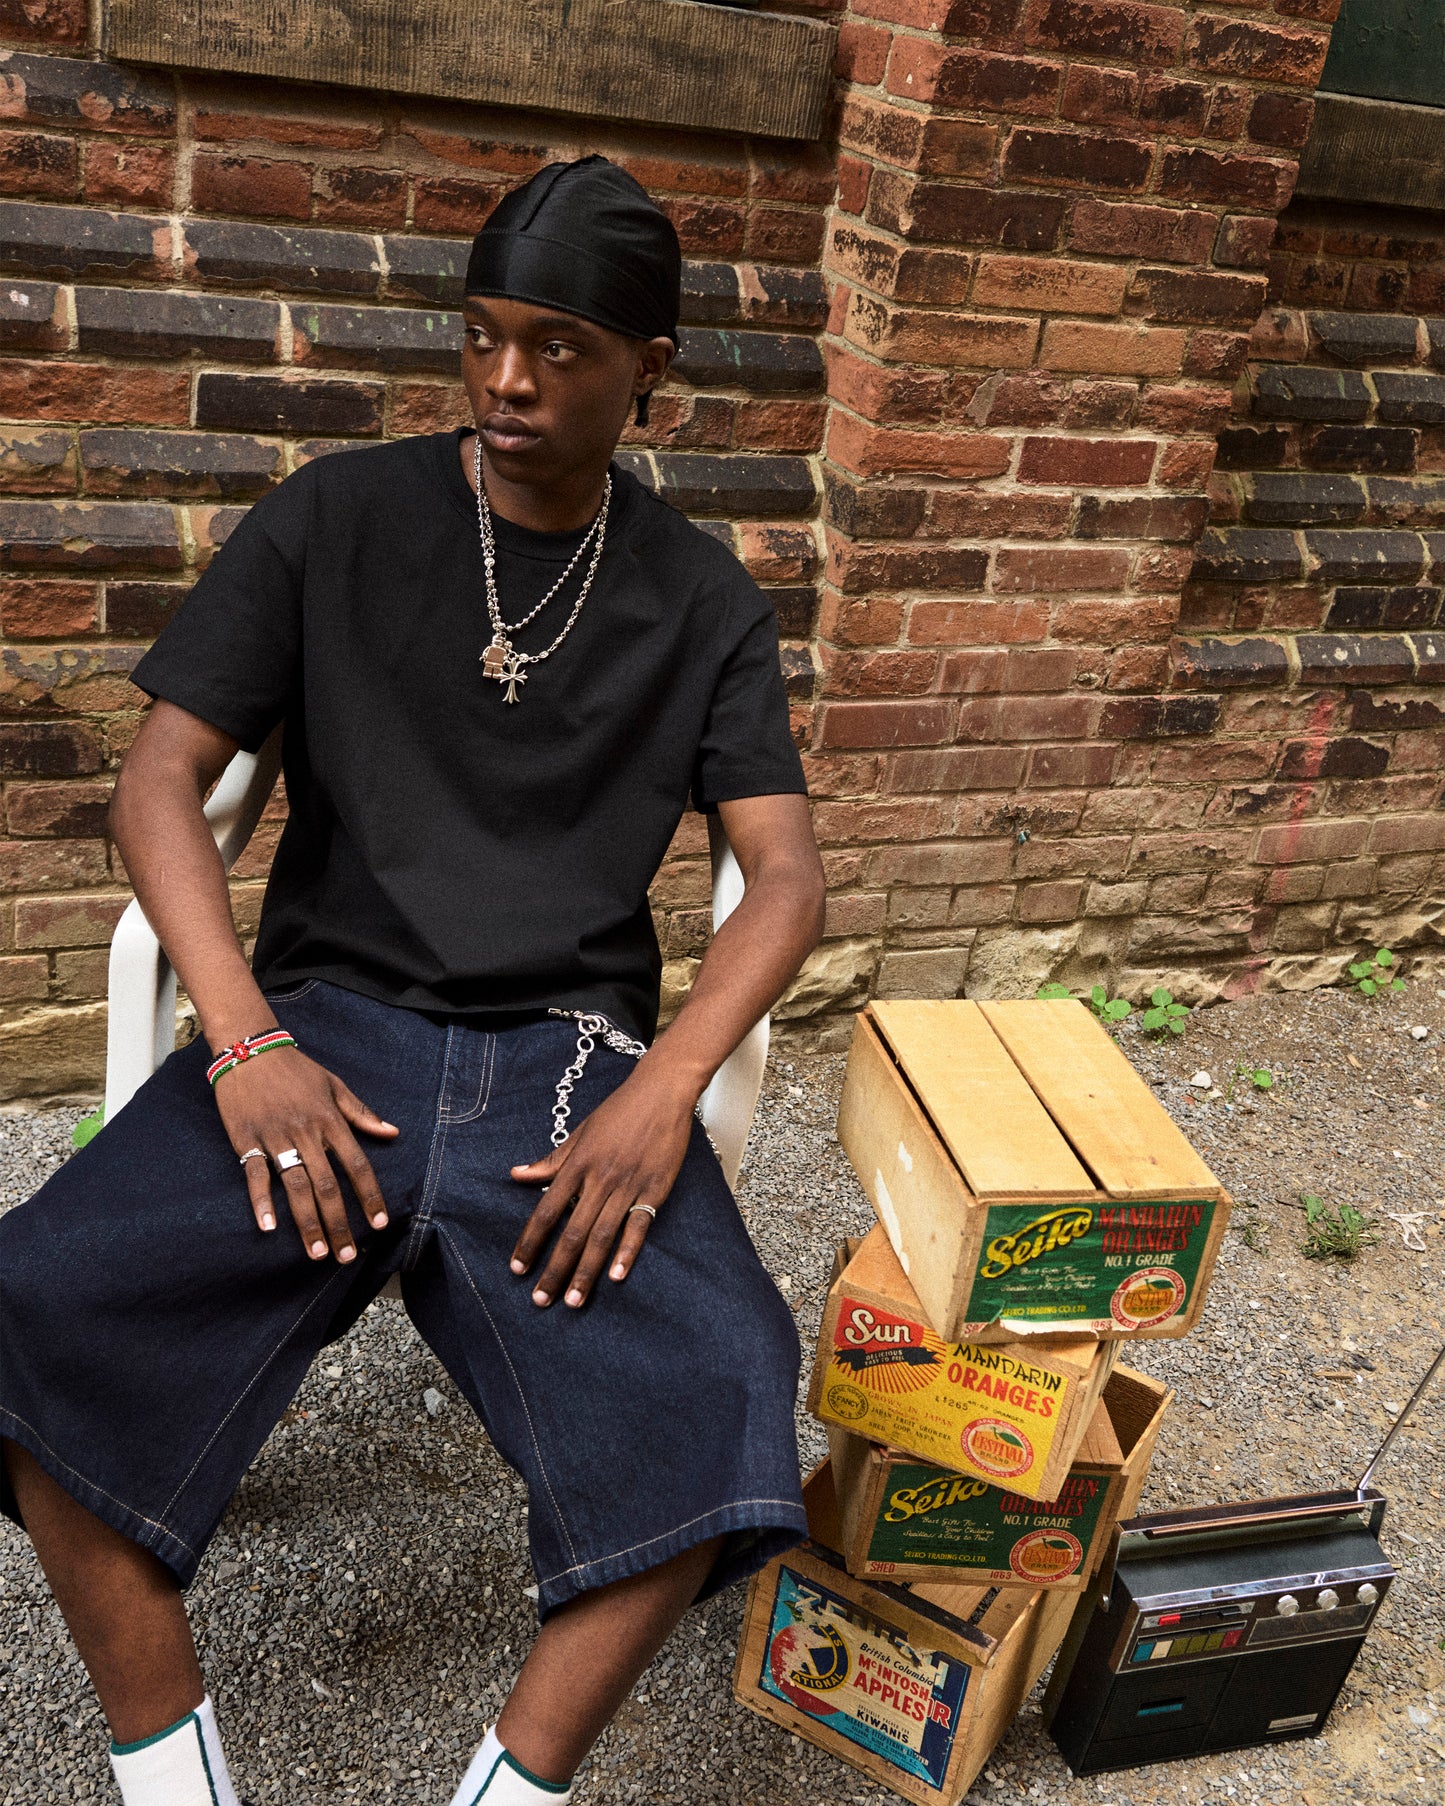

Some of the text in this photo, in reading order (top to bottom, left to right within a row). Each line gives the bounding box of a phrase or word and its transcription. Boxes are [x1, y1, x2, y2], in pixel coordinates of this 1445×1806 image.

[1099, 1205, 1205, 1230] MANDARIN
[980, 1207, 1093, 1279] Seiko
[1102, 1228, 1194, 1253] ORANGES
[1135, 1253, 1175, 1266] GRADE
[844, 1308, 912, 1344] Sun
[866, 1350, 903, 1361] DELICIOUS
[953, 1343, 1062, 1392] MANDARIN
[837, 1396, 860, 1408] FANCY
[947, 1362, 1055, 1418] ORANGES
[971, 1430, 1023, 1462] FESTIVAL
[884, 1474, 988, 1523] Seiko
[1033, 1517, 1073, 1528] GRADE
[869, 1562, 896, 1573] SHED
[904, 1551, 926, 1559] SEIKO
[927, 1552, 958, 1560] TRADING
[1023, 1547, 1071, 1564] FESTIVAL
[860, 1643, 891, 1664] British
[893, 1661, 934, 1686] Columbia
[853, 1671, 926, 1722] APPLES
[856, 1709, 909, 1744] KIWANIS
